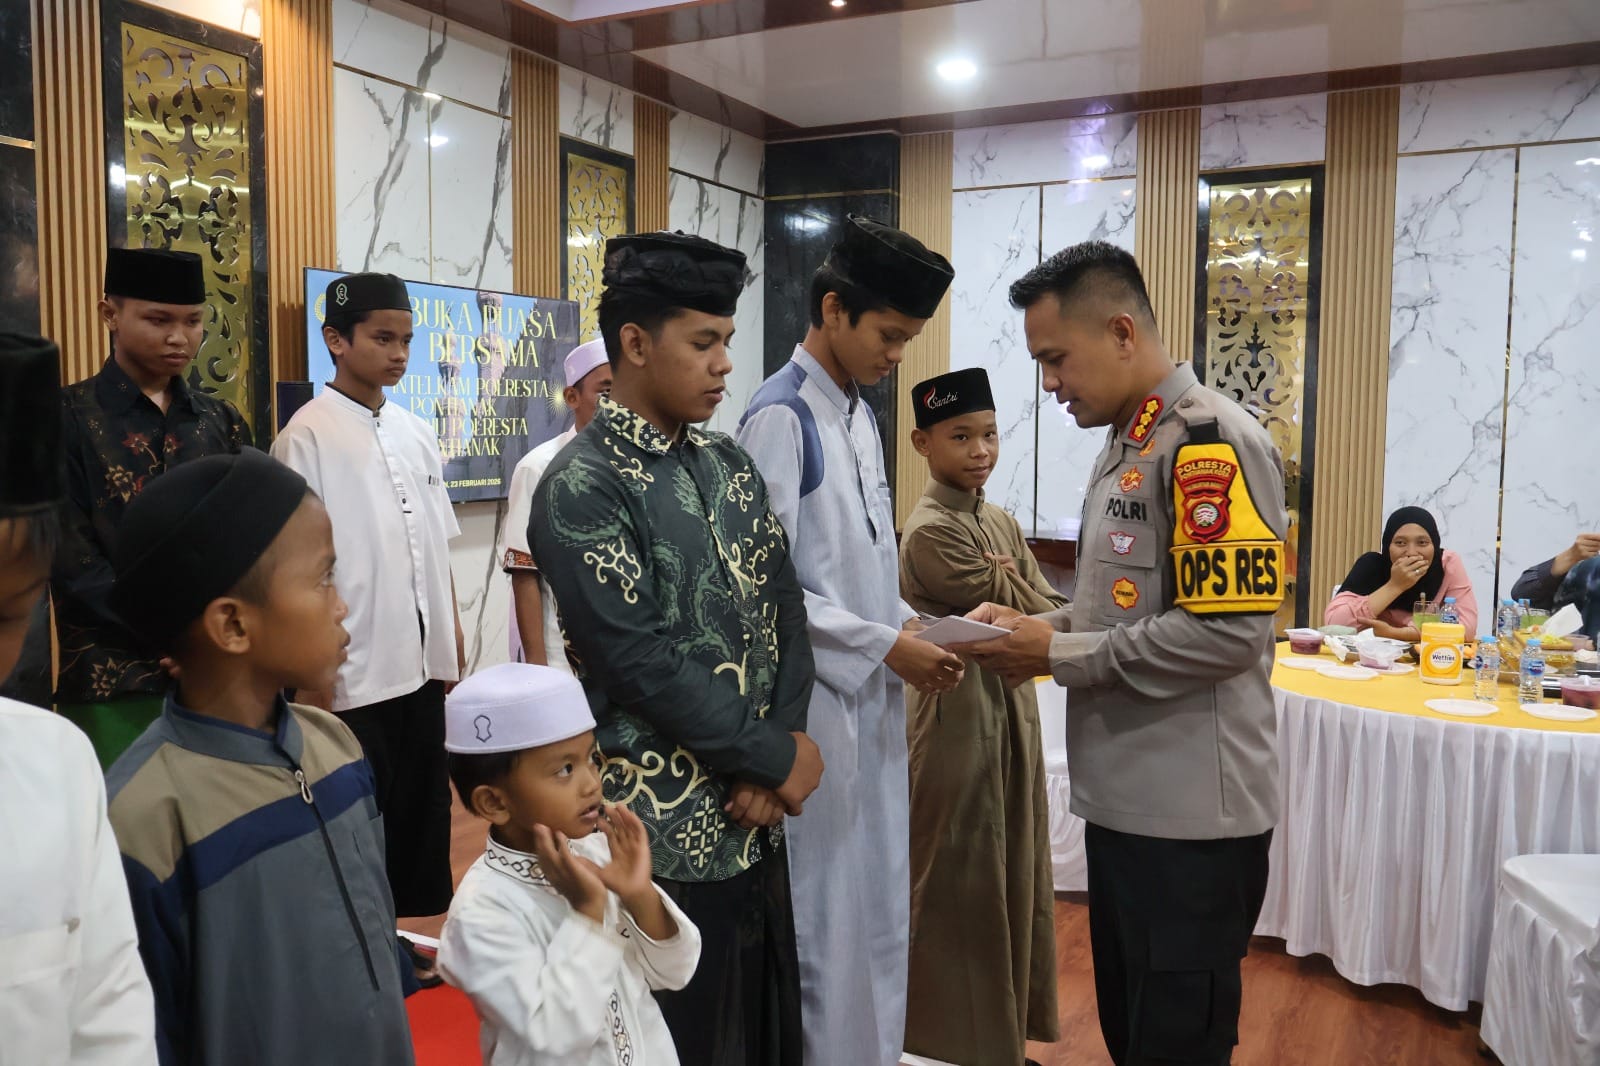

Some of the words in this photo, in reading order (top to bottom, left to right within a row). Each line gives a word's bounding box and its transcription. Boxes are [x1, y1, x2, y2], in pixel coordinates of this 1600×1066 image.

[408, 296, 473, 332] BUKA
[483, 304, 557, 340] PUASA
[429, 332, 539, 368] BERSAMA
[476, 377, 549, 398] POLRESTA
[410, 396, 497, 417] PONTIANAK
[928, 391, 958, 410] Santri
[452, 417, 529, 436] POLRESTA
[437, 437, 500, 457] NTIANAK
[1177, 461, 1232, 475] POLRESTA
[459, 478, 486, 487] FEBRUARI
[1105, 497, 1147, 521] POLRI
[1181, 548, 1228, 597] OPS
[1235, 547, 1278, 595] RES
